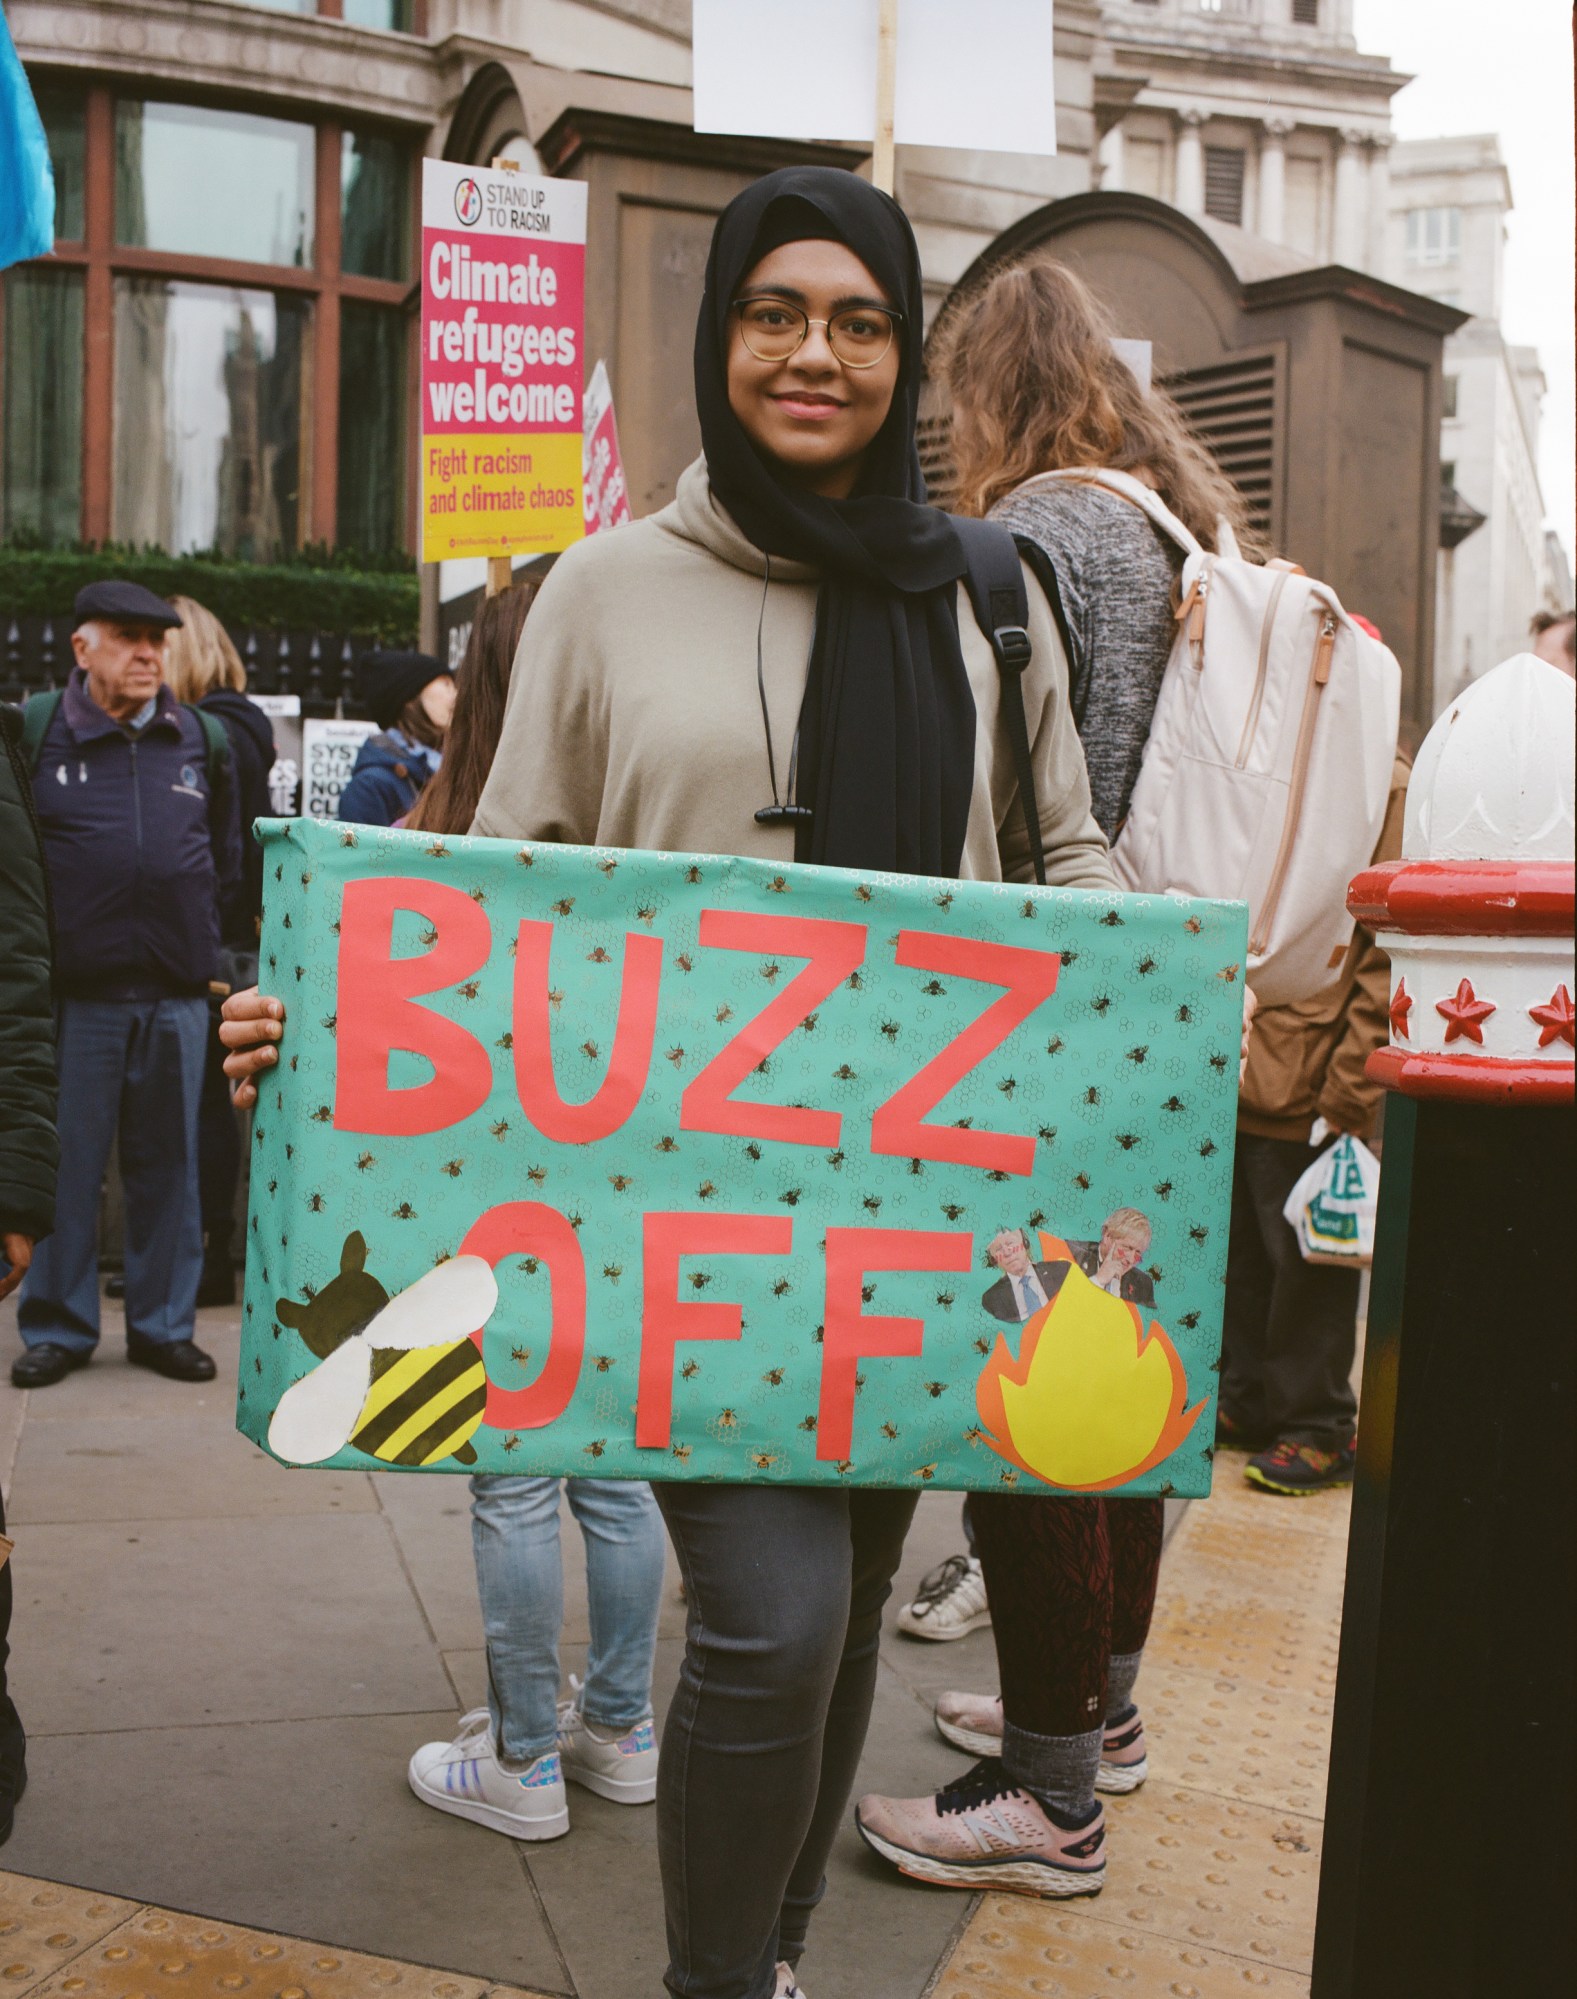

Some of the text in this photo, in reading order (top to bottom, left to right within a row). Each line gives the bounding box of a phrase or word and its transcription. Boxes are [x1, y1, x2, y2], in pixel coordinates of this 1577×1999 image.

[487, 184, 545, 209] STAND UP
[487, 207, 551, 233] TO RACISM
[429, 240, 557, 307] Climate
[429, 306, 576, 378] refugees
[429, 368, 575, 423] welcome
[430, 447, 532, 483] Fight racism
[430, 485, 457, 514] and
[462, 483, 525, 512] climate
[529, 482, 575, 509] chaos
[334, 876, 1060, 1177] BUZZ
[457, 1201, 973, 1462] OFF
